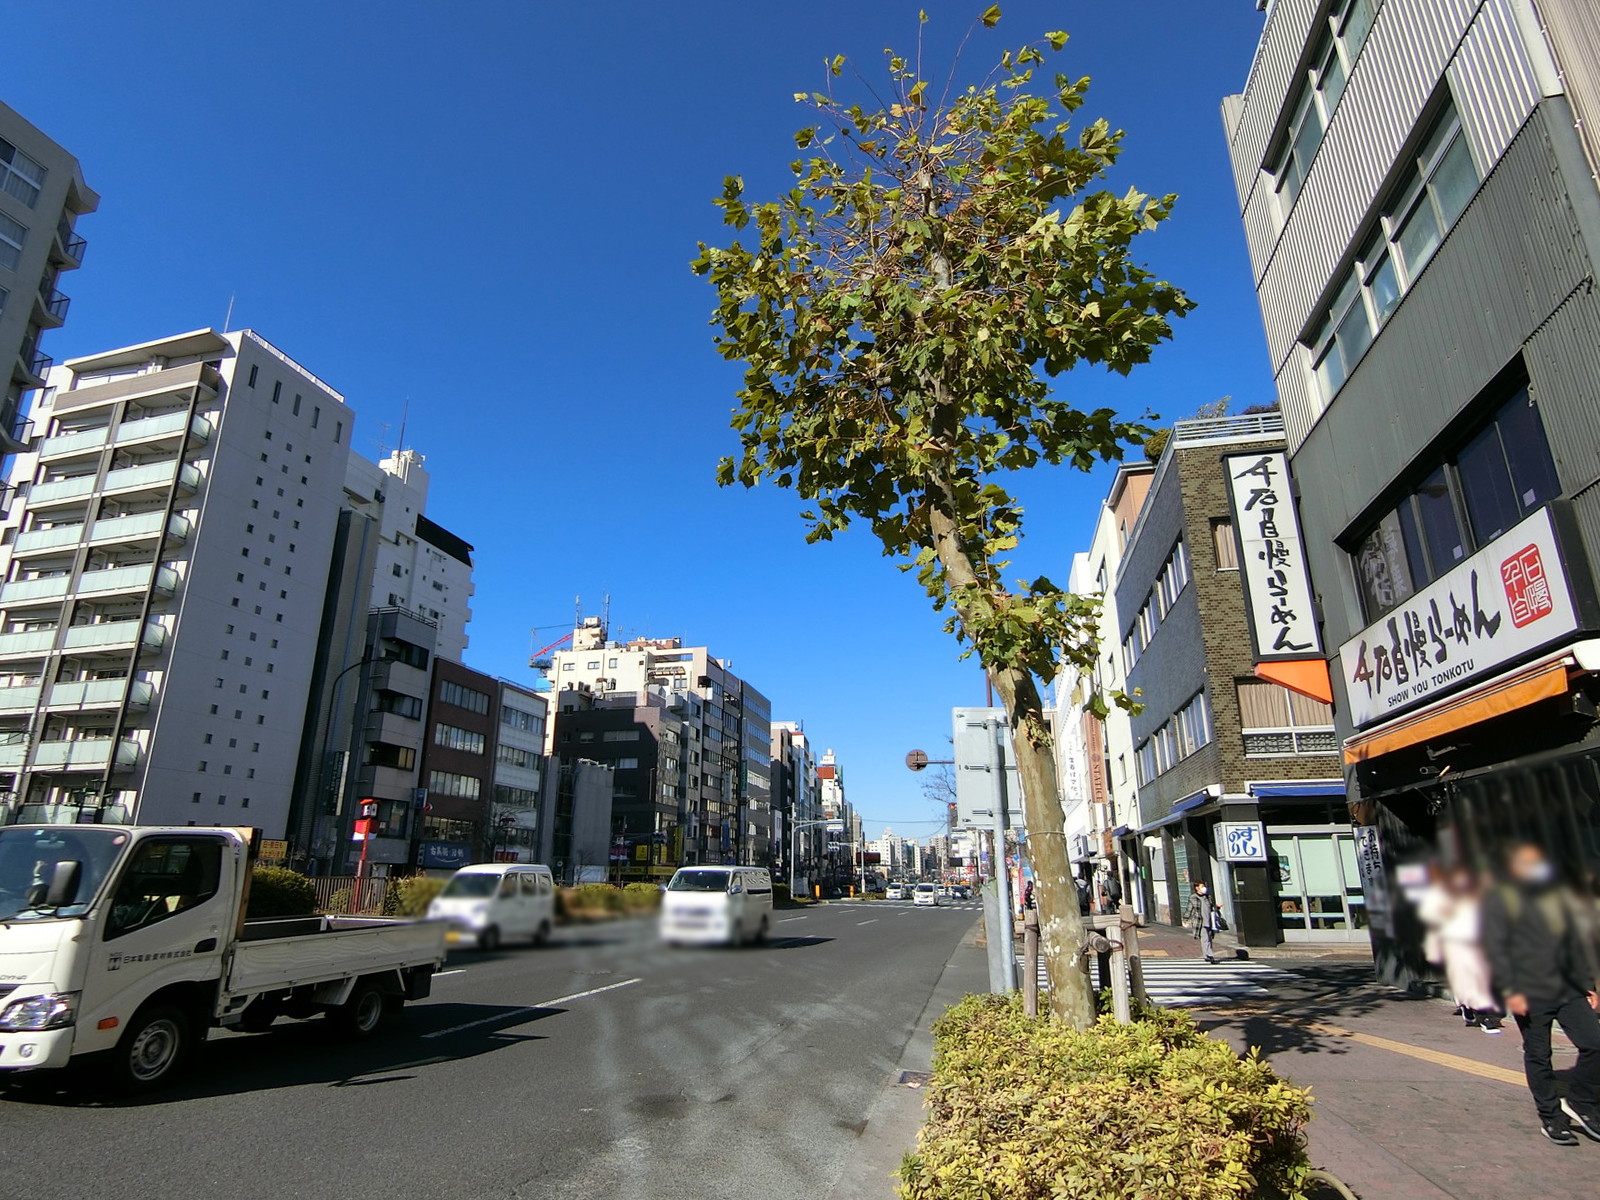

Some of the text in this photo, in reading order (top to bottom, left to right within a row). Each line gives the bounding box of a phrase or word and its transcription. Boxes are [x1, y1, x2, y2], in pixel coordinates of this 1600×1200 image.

[1233, 456, 1313, 651] 千石自慢らーめん
[1353, 569, 1501, 699] 千石自慢らーめん
[1387, 659, 1475, 707] SHOW YOU TONKOTU
